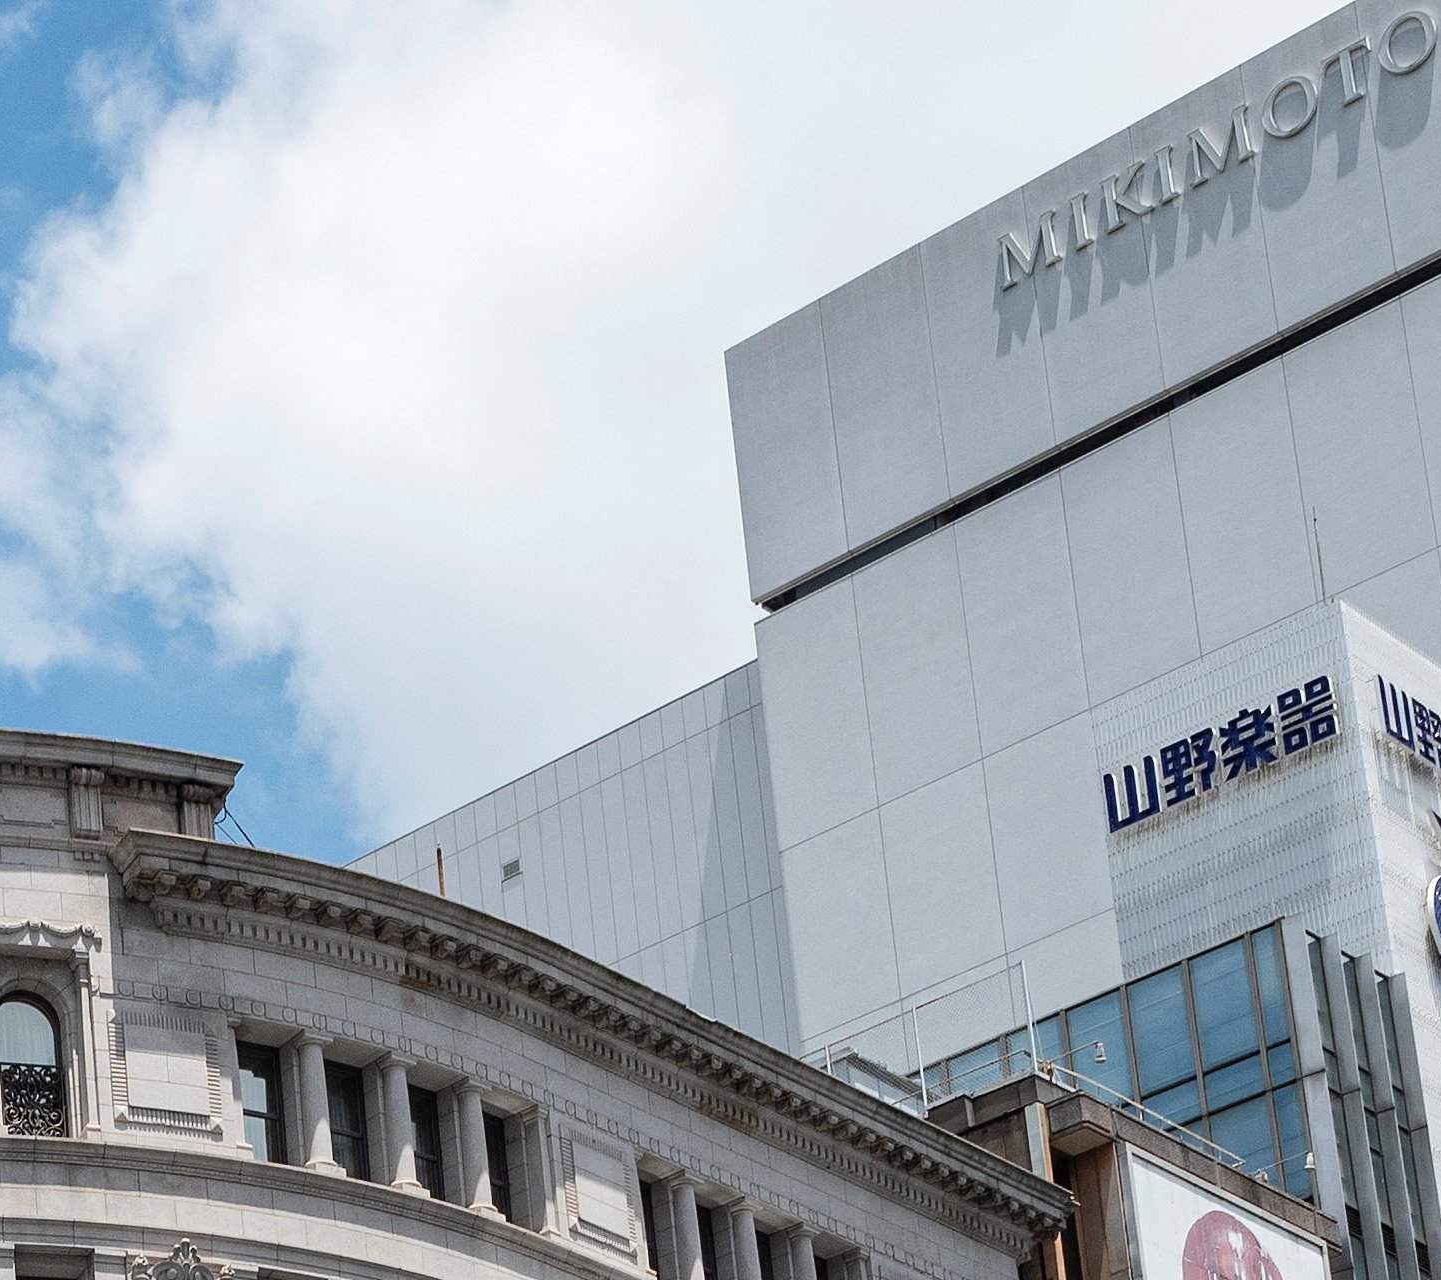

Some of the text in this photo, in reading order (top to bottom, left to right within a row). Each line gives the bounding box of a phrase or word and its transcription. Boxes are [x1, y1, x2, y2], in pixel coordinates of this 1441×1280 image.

[995, 9, 1439, 292] MIKIMOTO
[1103, 675, 1341, 834] 山野楽器
